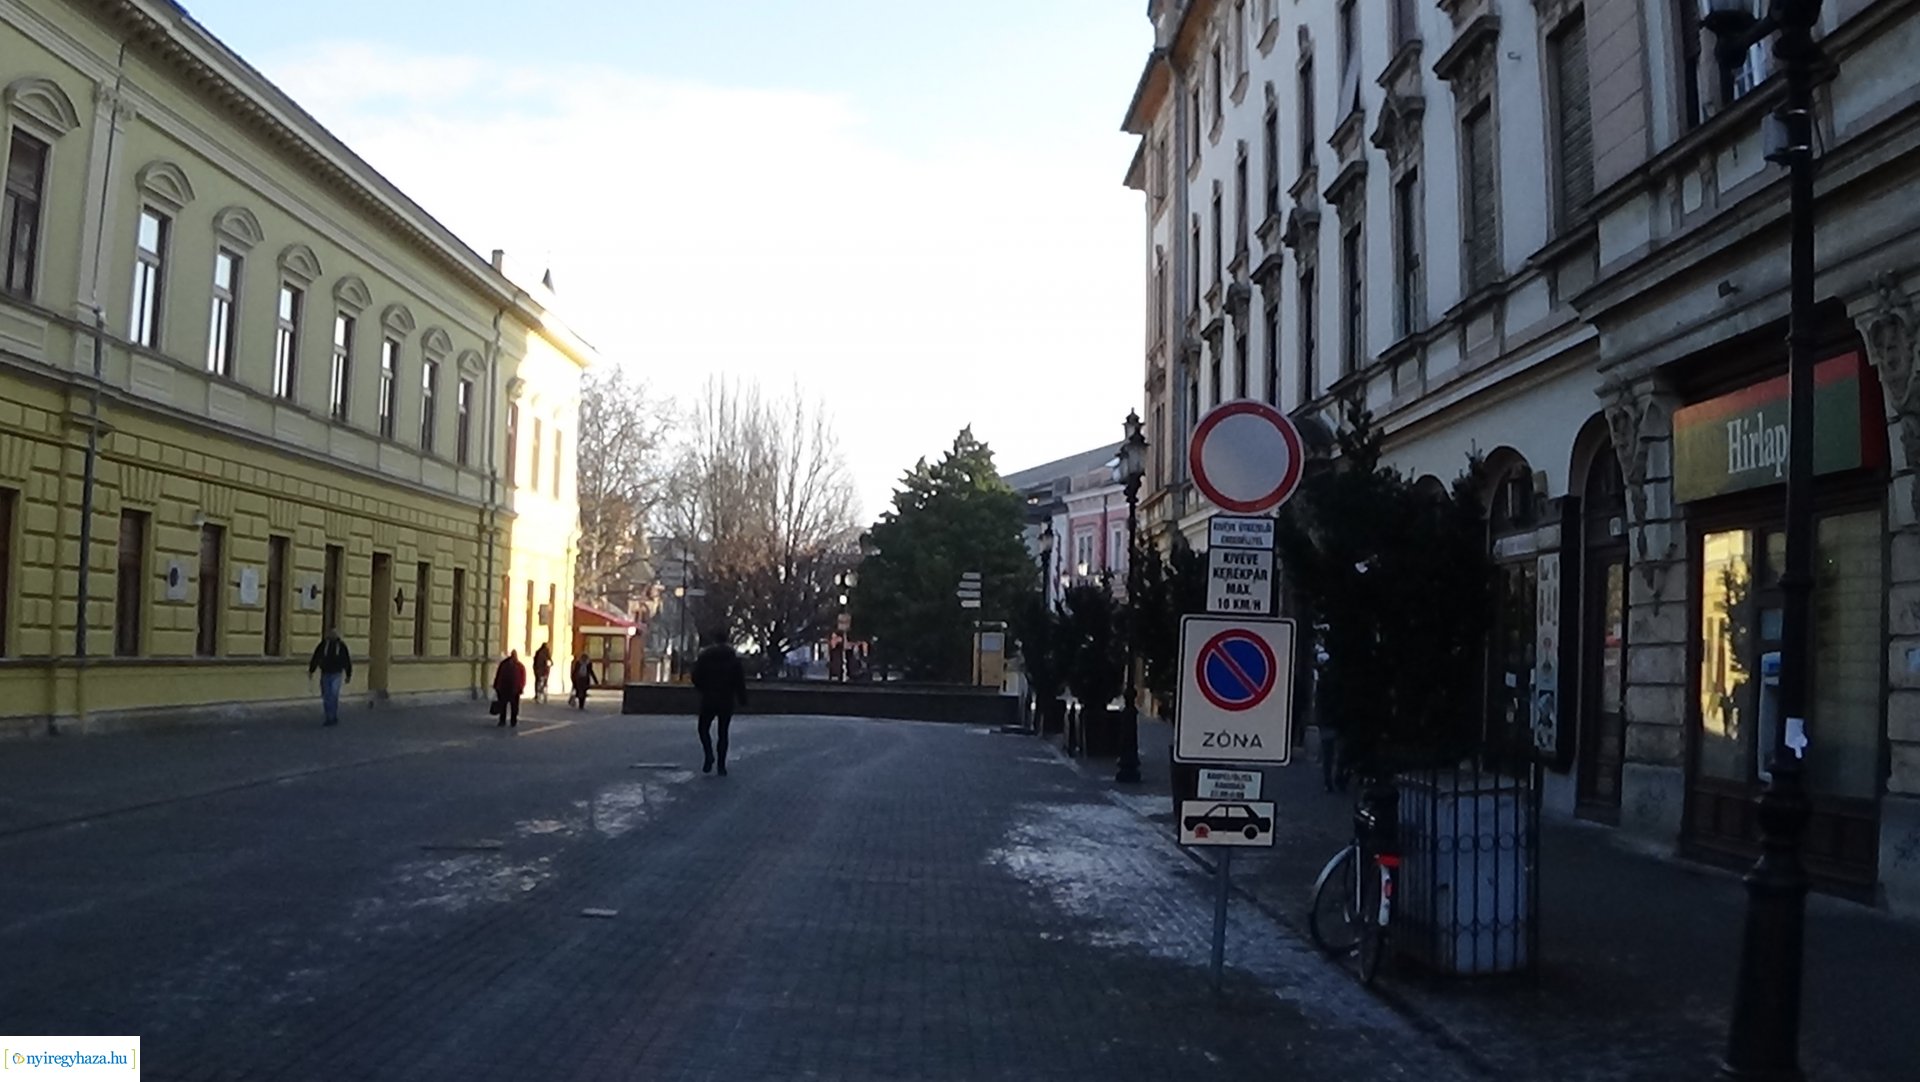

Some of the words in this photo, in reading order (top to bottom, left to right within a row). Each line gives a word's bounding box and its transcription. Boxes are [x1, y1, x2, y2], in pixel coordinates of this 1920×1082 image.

[1223, 552, 1258, 565] KIVÉVE
[1213, 567, 1267, 581] KEREKPÁR
[1226, 583, 1252, 595] MAX.
[1218, 597, 1230, 610] 10
[1233, 599, 1261, 611] KM/H
[1202, 729, 1263, 748] ZÓNA
